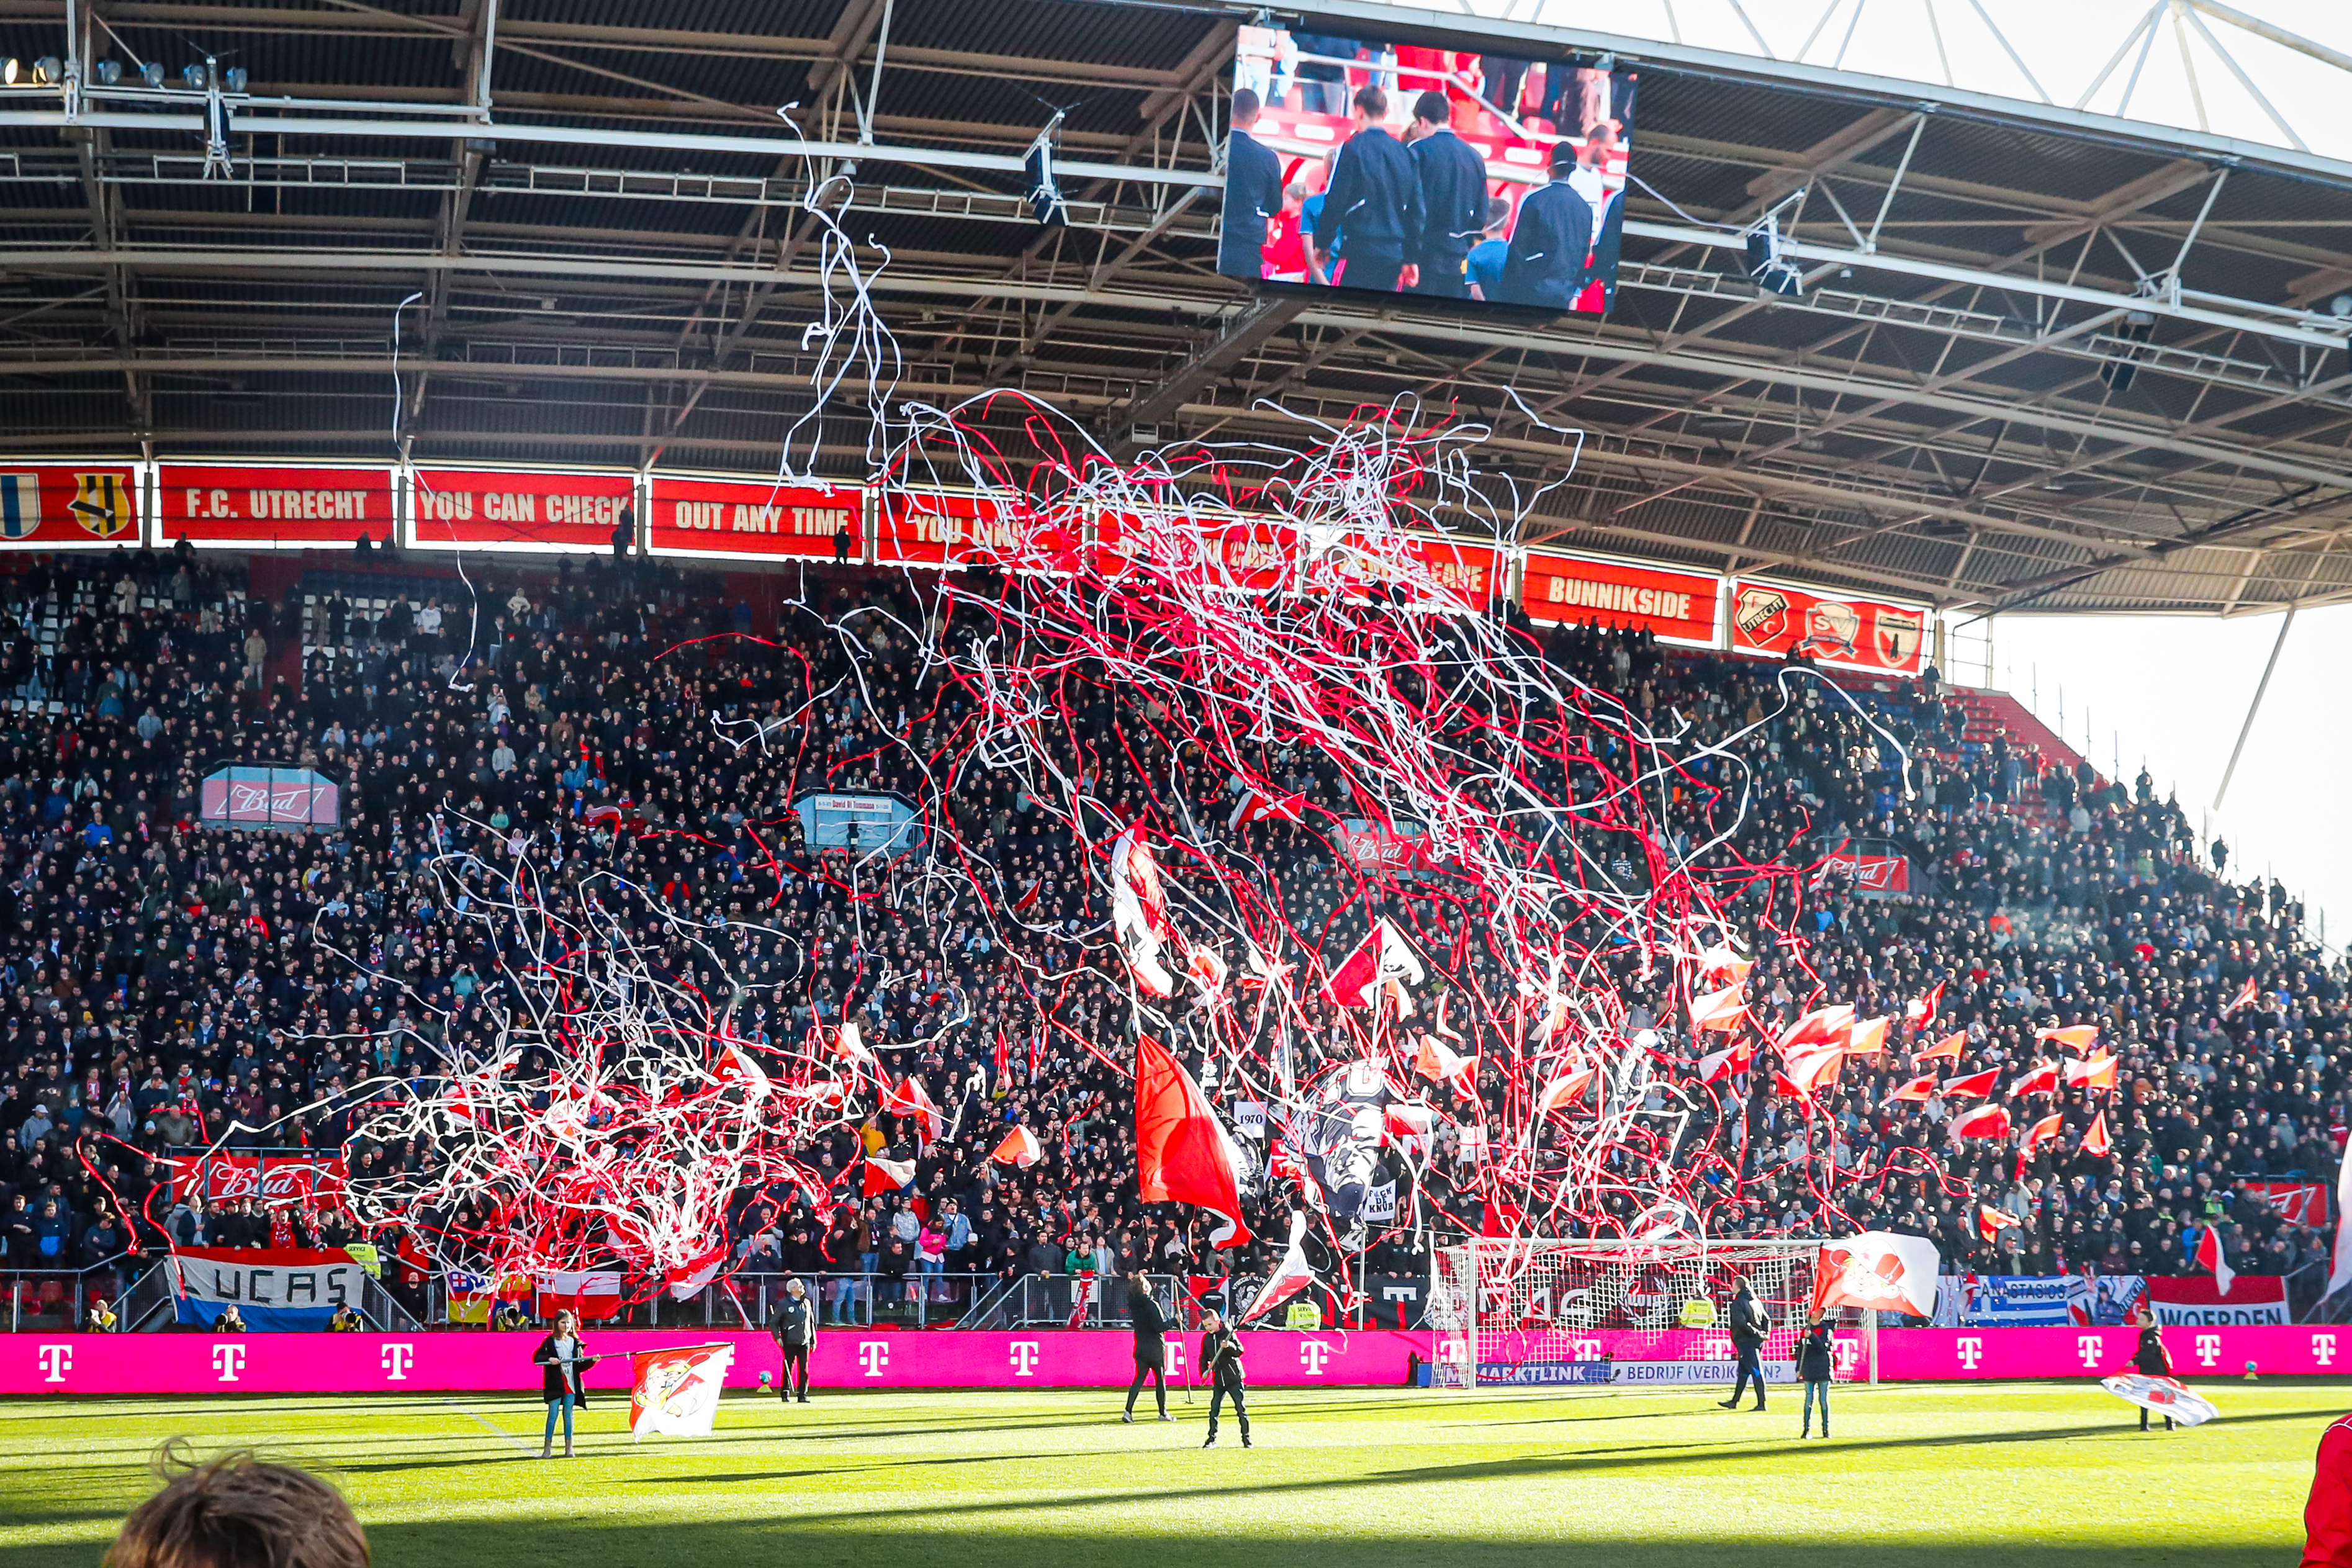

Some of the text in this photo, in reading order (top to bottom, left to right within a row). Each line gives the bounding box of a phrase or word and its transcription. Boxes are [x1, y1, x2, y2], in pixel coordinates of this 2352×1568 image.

[187, 489, 367, 520] F.C. UTRECHT
[419, 491, 629, 526] YOU CAN CHECK
[675, 501, 849, 536] OUT ANY TIME
[914, 514, 962, 544] YOU
[1549, 577, 1692, 620] BUNNIKSIDE
[1742, 600, 1786, 633] UTRECHT
[1813, 614, 1854, 636] SV
[237, 788, 297, 811] Bud
[1353, 839, 1403, 861] Bud
[1240, 1114, 1263, 1125] 1970
[215, 1166, 295, 1196] Bud
[1369, 1202, 1394, 1214] KNVB
[1981, 1283, 2066, 1299] ANASTASIOS
[2158, 1307, 2282, 1326] WOERDEN
[1627, 1366, 1683, 1379] BEDRIJF
